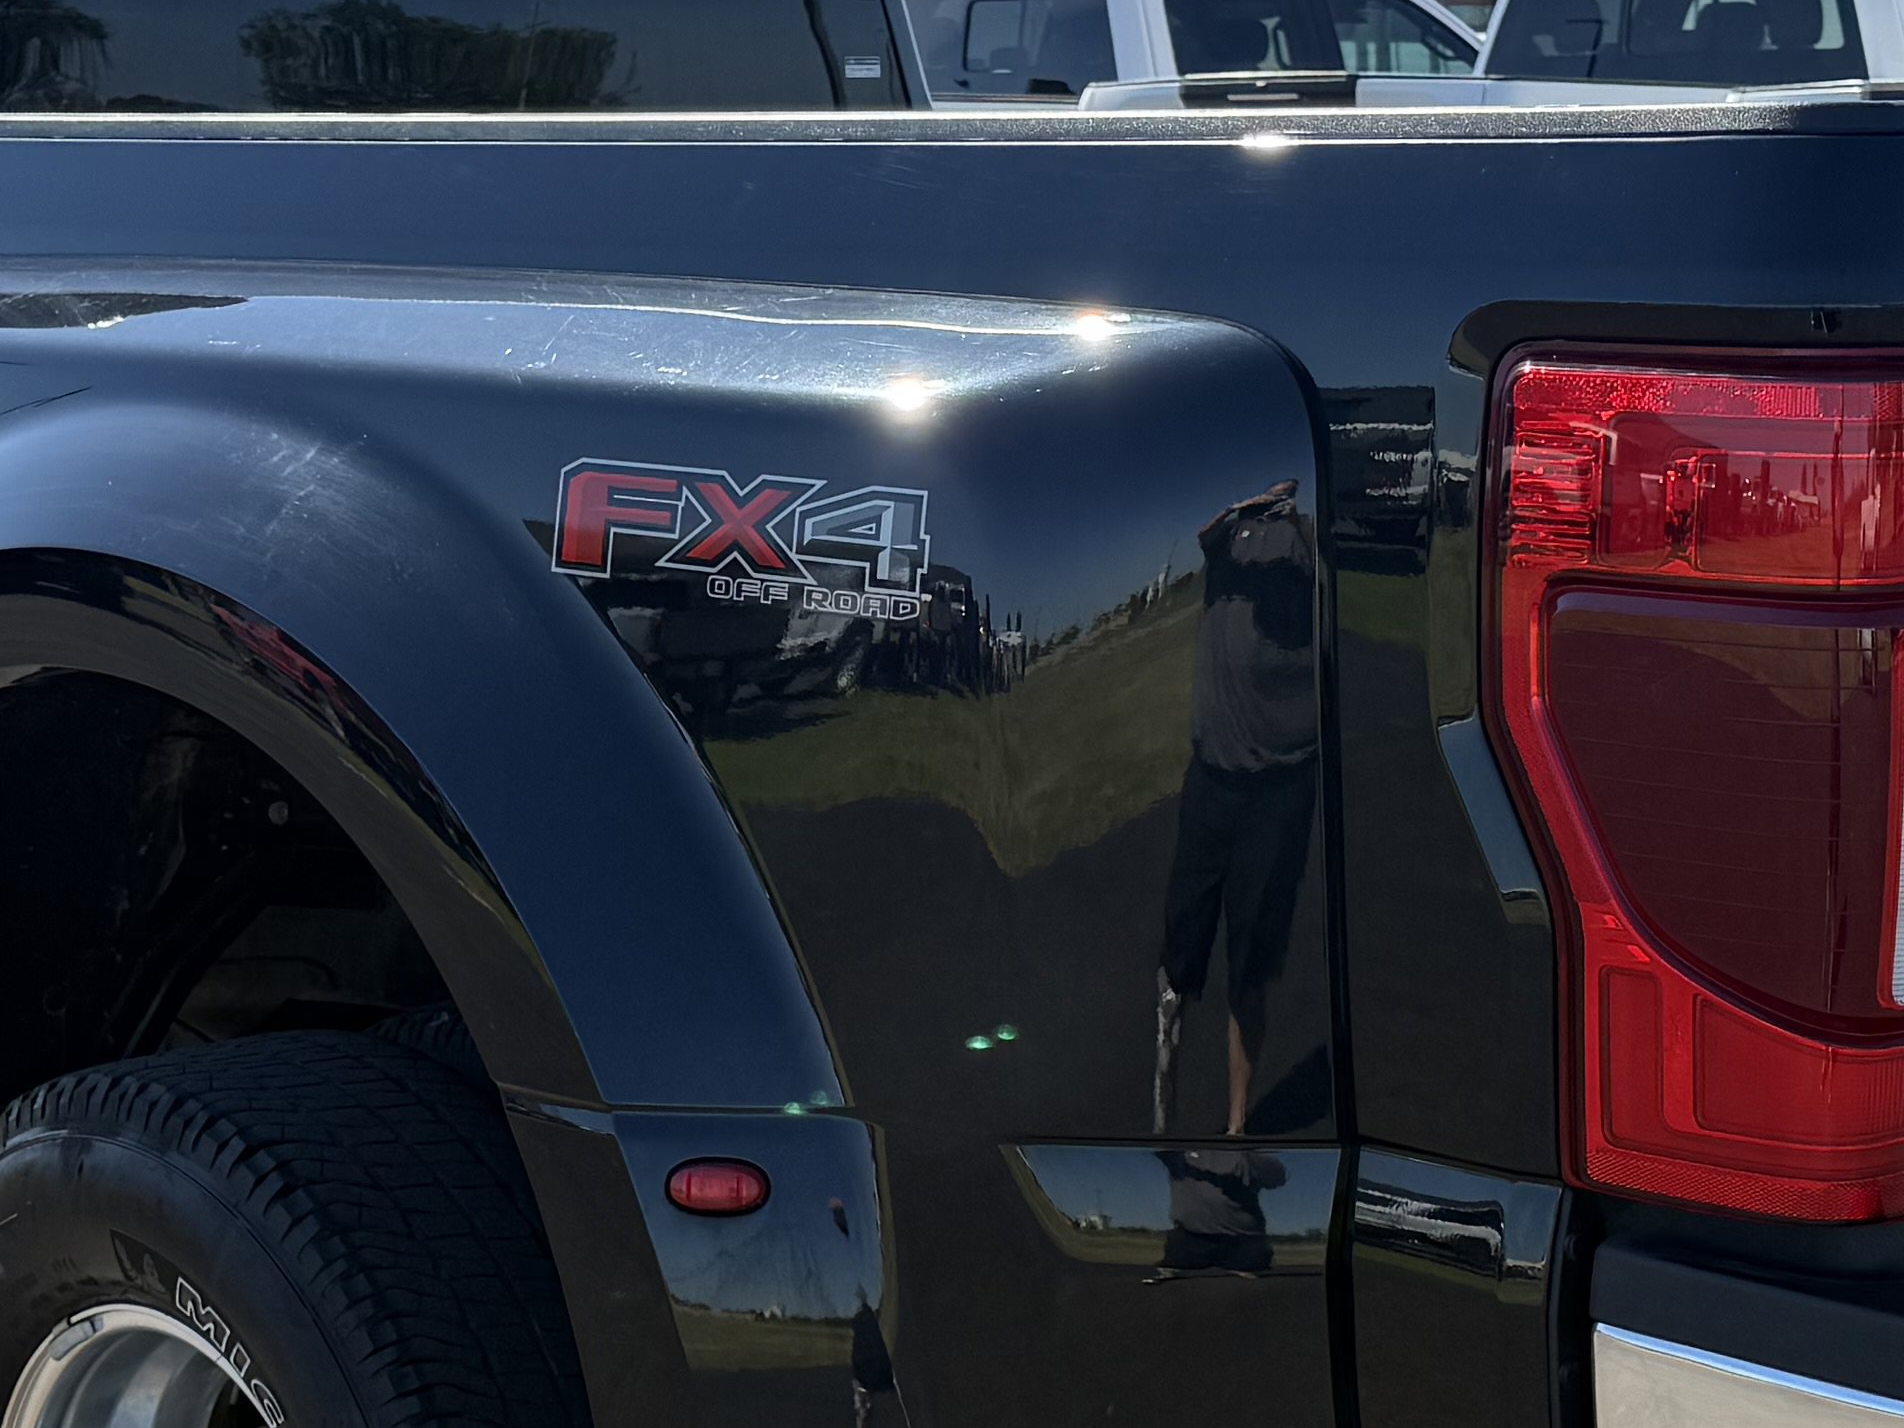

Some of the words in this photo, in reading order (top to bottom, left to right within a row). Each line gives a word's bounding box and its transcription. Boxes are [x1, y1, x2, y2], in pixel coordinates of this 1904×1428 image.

[551, 457, 930, 596] FX4
[707, 575, 790, 604] OFF
[803, 586, 921, 621] ROAD
